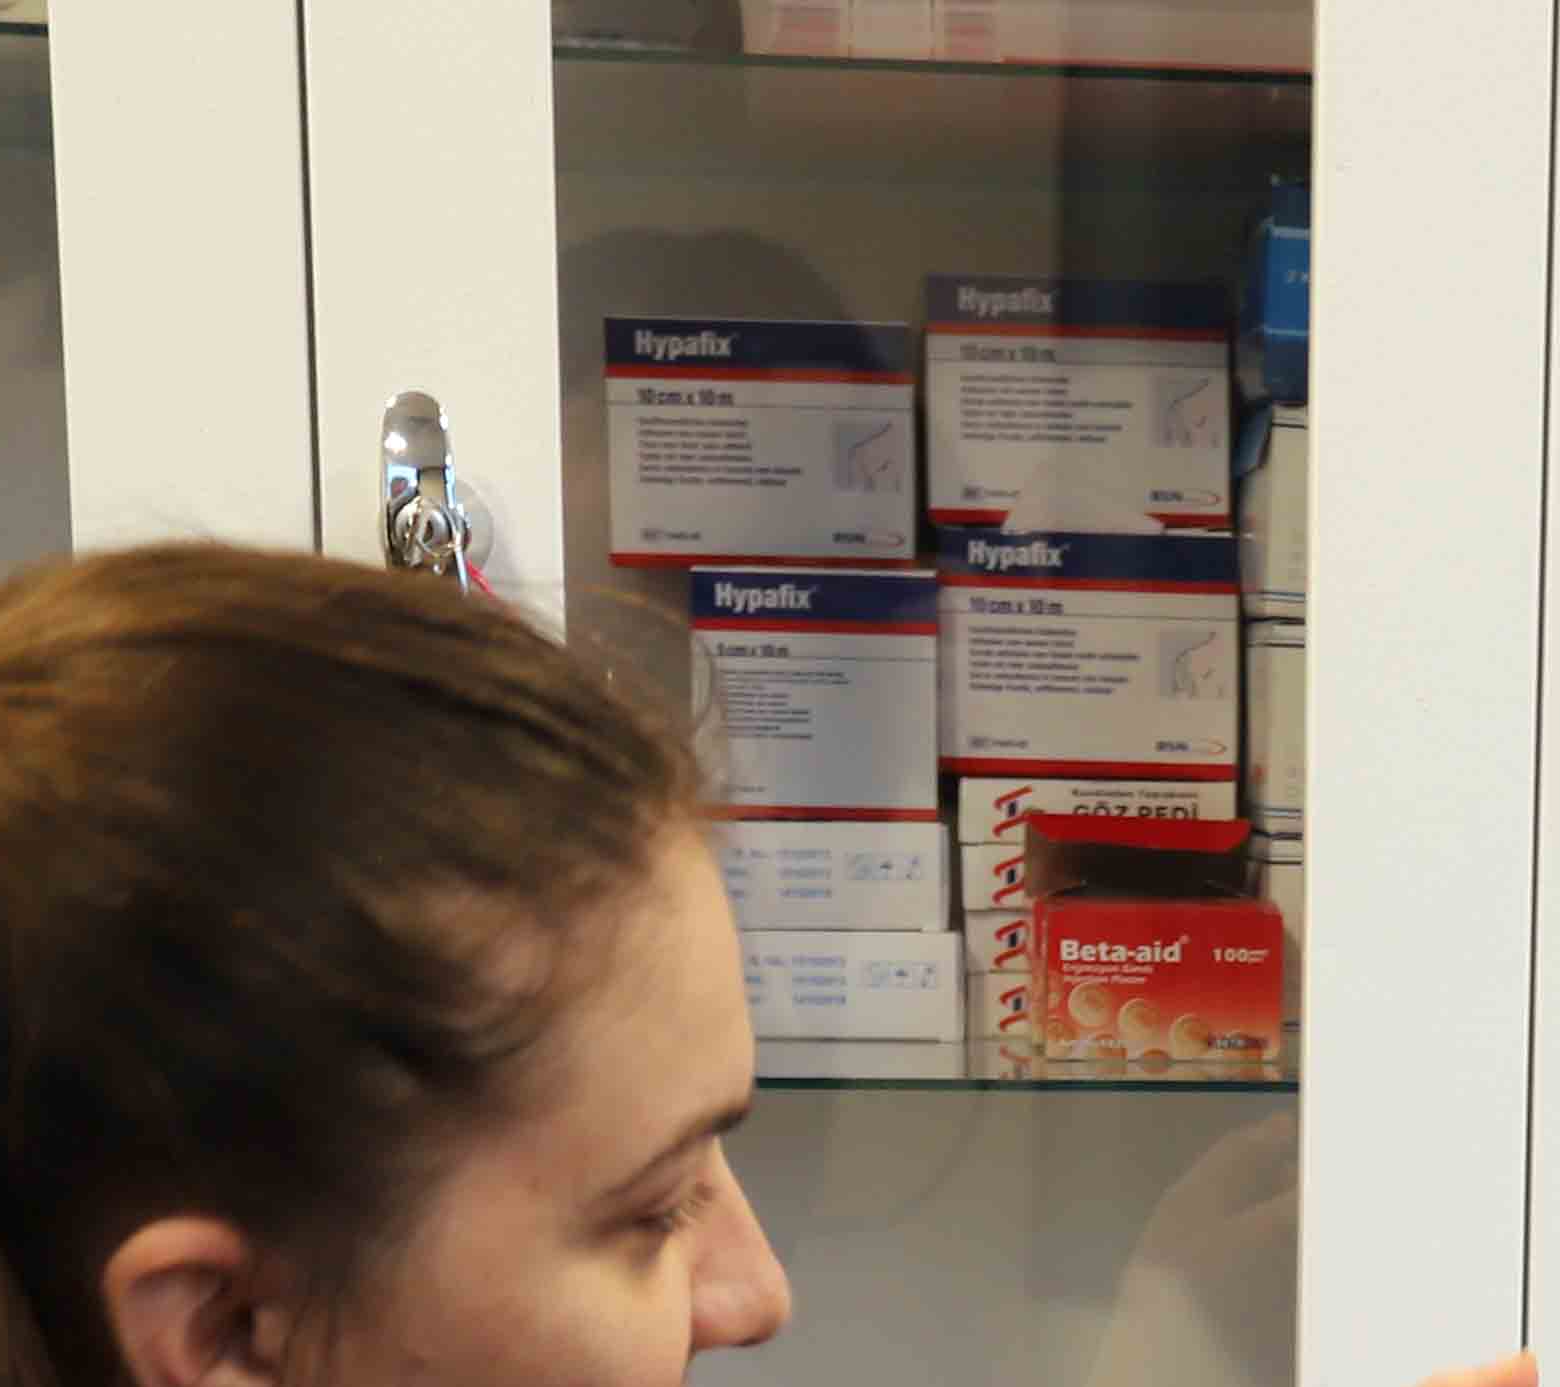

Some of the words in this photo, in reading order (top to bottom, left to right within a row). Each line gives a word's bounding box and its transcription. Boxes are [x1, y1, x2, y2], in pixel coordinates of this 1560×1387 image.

[957, 286, 1053, 318] Hypafix
[634, 329, 732, 360] Hypafix
[968, 540, 1063, 571] Hypafix
[714, 582, 812, 613] Hypafix
[1059, 939, 1182, 963] Beta-aid
[1213, 947, 1248, 963] 100
